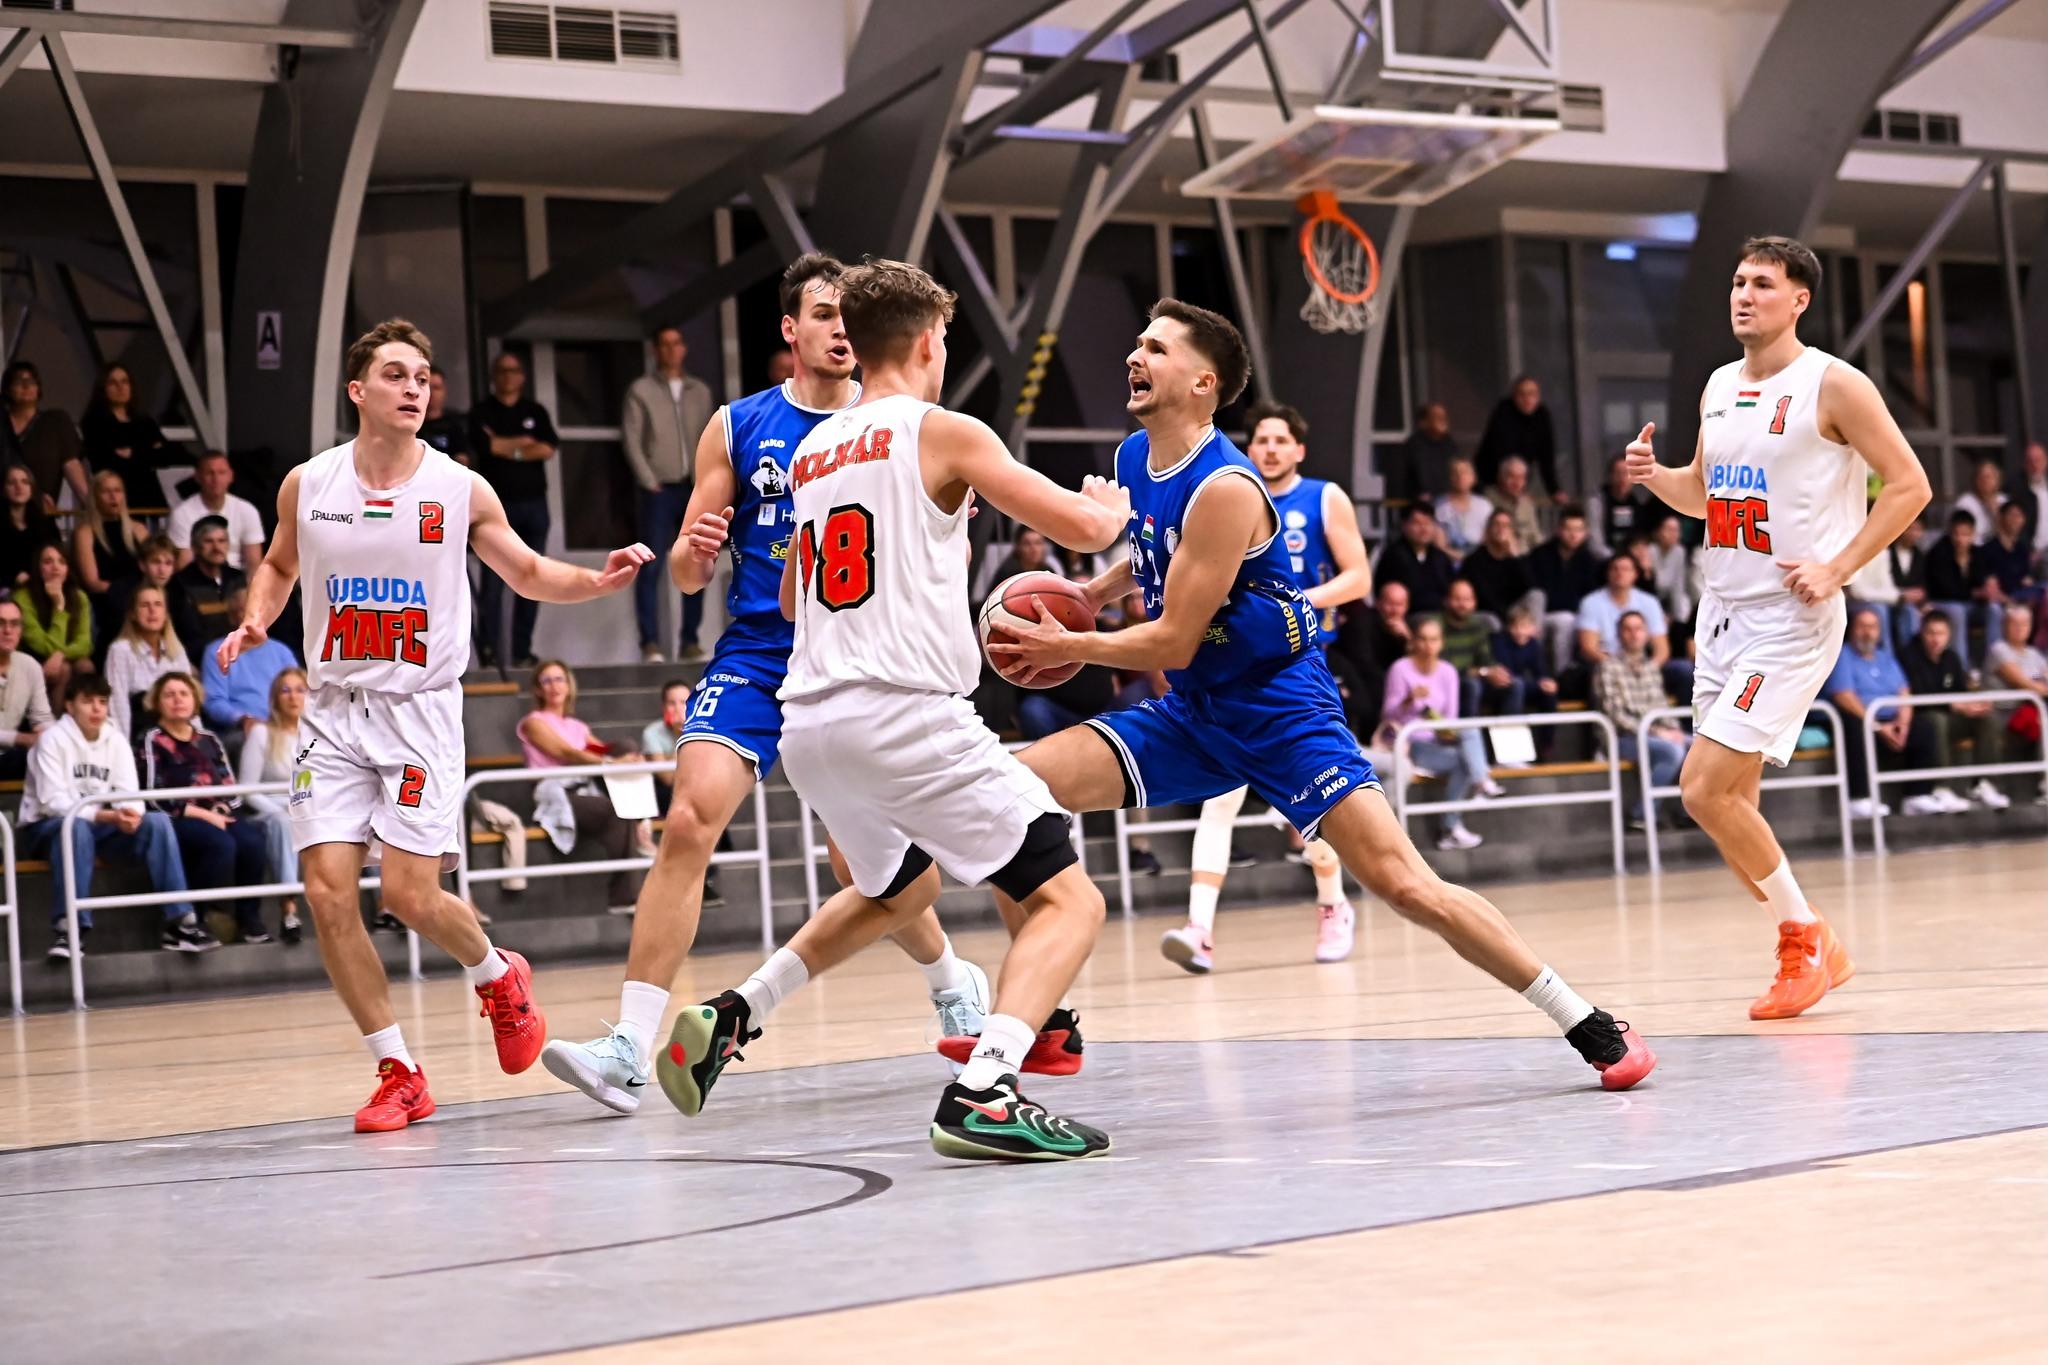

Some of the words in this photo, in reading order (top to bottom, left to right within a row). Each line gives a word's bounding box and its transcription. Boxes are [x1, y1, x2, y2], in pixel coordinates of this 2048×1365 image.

[259, 315, 278, 352] A
[1768, 395, 1792, 434] 1
[758, 438, 786, 449] JAKO
[793, 424, 893, 491] MOLNÁR
[310, 509, 353, 524] SPALDING
[419, 501, 443, 543] 2
[326, 574, 427, 606] ÚJBUDA
[320, 604, 428, 668] MAFC
[1733, 673, 1765, 712] 1
[396, 763, 427, 808] 2
[1314, 765, 1339, 786] GROUP
[1321, 776, 1349, 800] JAKO
